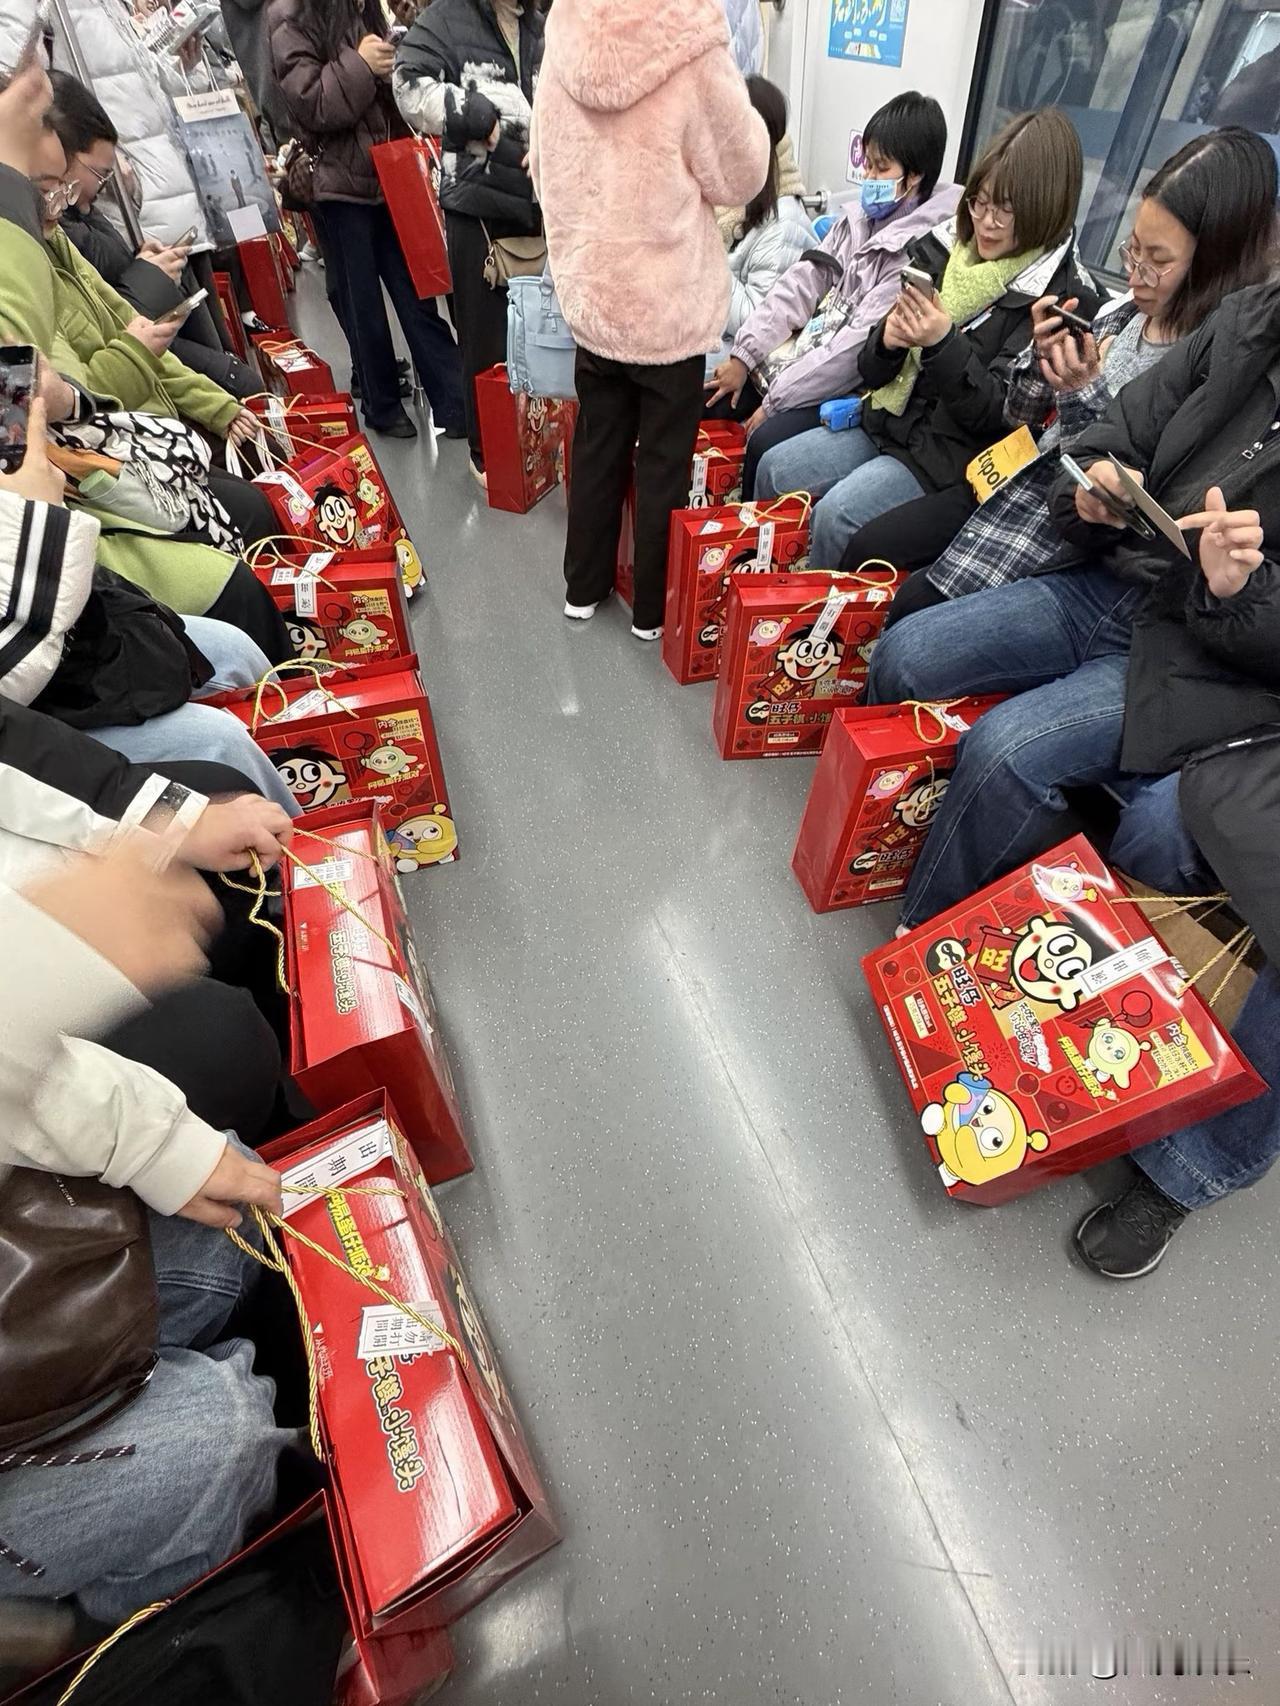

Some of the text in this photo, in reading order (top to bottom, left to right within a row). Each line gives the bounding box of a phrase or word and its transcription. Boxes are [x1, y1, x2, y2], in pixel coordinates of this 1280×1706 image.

[772, 676, 795, 696] 旺
[770, 702, 801, 714] 旺仔
[980, 947, 1012, 972] 旺
[951, 965, 982, 1007] 旺仔
[932, 973, 991, 1081] 五子棋小馒头
[1166, 1022, 1188, 1046] 内含
[294, 1131, 389, 1196] 出期間
